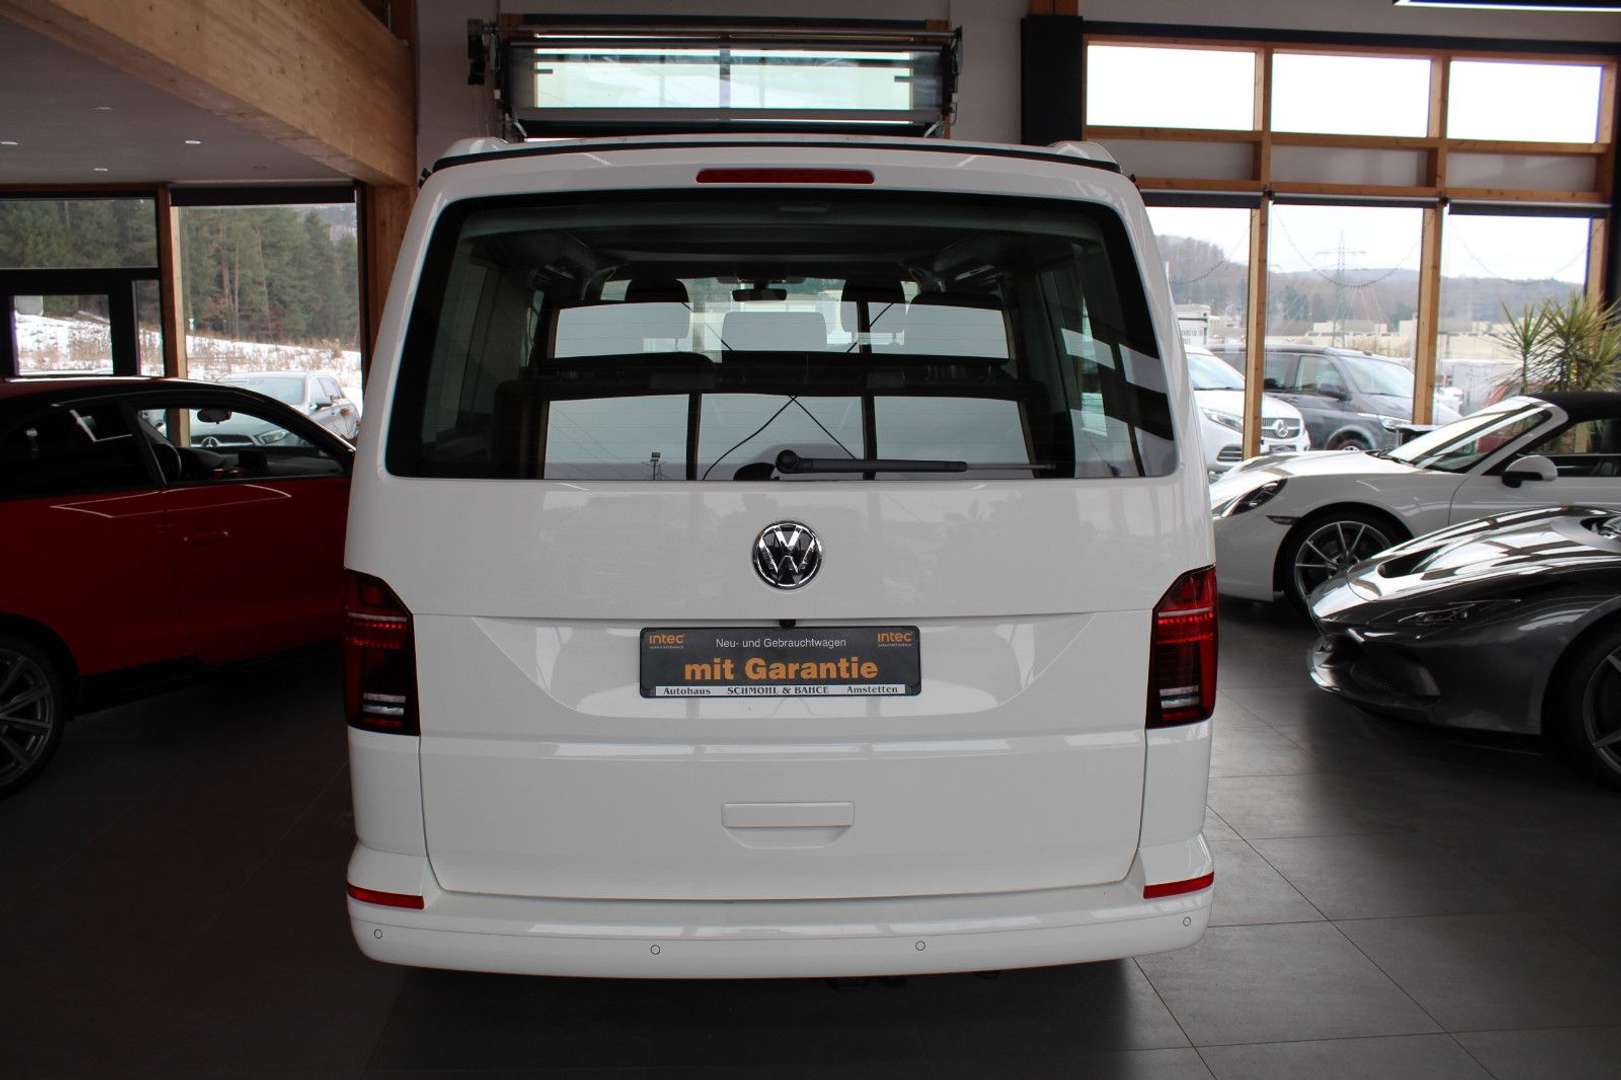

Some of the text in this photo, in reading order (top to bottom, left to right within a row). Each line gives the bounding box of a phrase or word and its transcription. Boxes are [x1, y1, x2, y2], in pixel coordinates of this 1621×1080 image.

[755, 523, 821, 587] VW
[649, 633, 685, 645] intec
[877, 632, 913, 643] intec
[716, 638, 847, 650] Neu- und Gebrauchtwagen
[684, 656, 879, 680] mit Garantie
[663, 687, 712, 695] Autohaus
[782, 686, 792, 695] &
[846, 685, 898, 694] Amstetten
